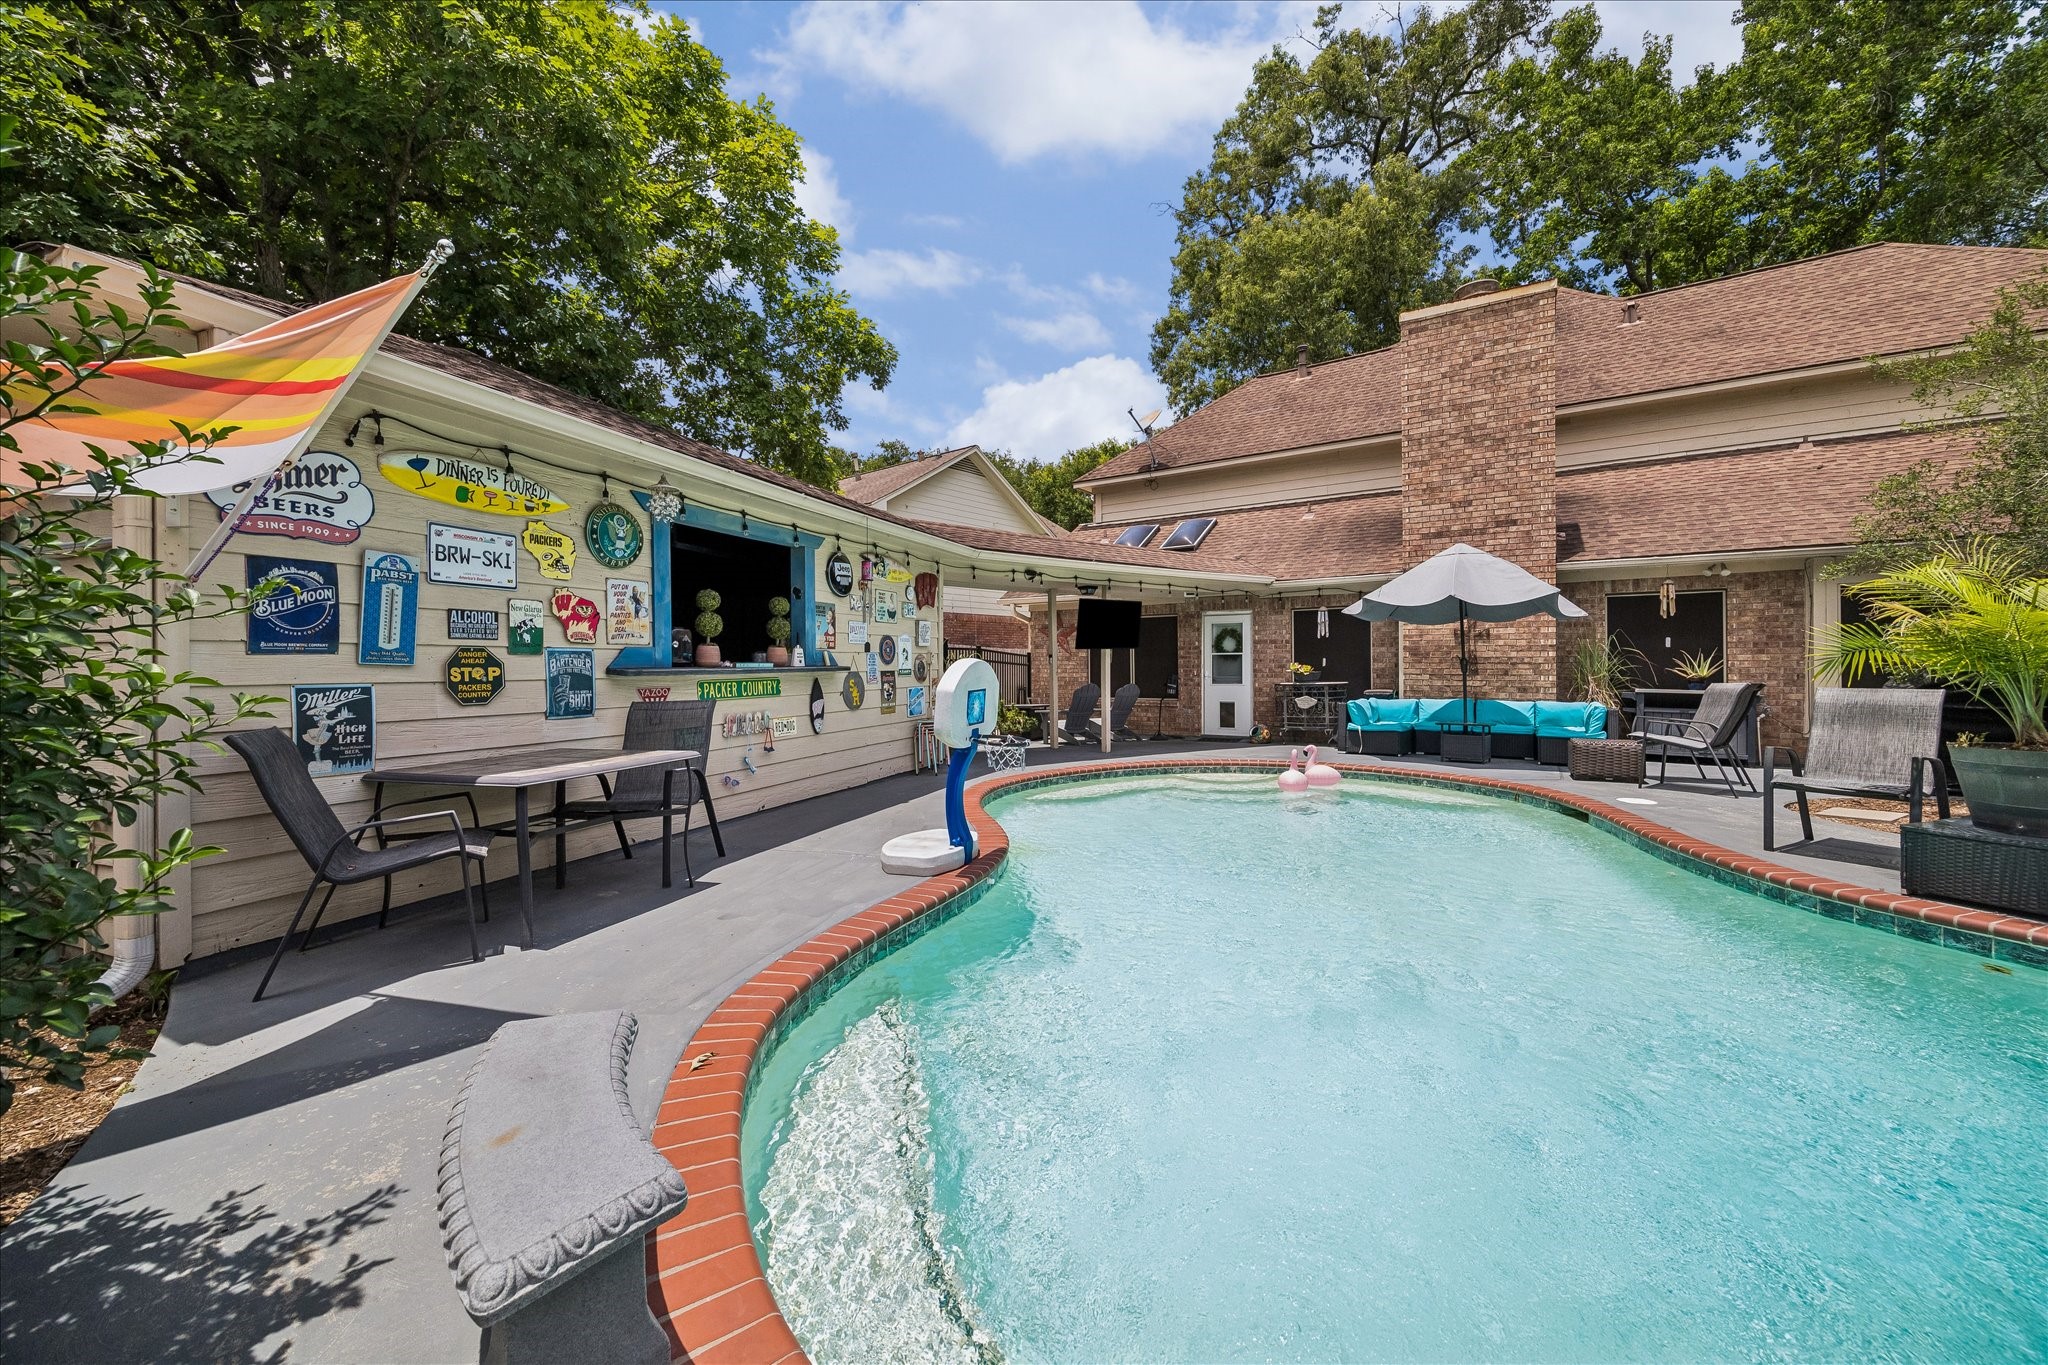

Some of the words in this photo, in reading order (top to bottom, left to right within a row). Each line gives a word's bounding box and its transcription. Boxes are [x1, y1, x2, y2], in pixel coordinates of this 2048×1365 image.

[436, 458, 487, 488] DINNER
[486, 467, 498, 483] IS
[254, 496, 335, 518] BEERS
[594, 505, 617, 522] UNITED
[257, 520, 295, 531] SINCE
[302, 525, 330, 537] 1909
[529, 533, 563, 548] PACKERS
[435, 543, 512, 570] BRW-SKI
[604, 557, 629, 566] ARMY
[370, 568, 415, 582] PABST
[837, 565, 851, 574] Jeep
[255, 597, 295, 617] BLUE
[297, 588, 333, 606] MOON
[511, 604, 523, 612] New
[523, 604, 542, 614] Glarus
[450, 610, 498, 624] ALCOHOL
[275, 627, 301, 635] DENVER
[304, 616, 331, 634] COLORADO
[549, 658, 592, 673] BARTENDER
[458, 683, 492, 691] PACKERS
[640, 688, 669, 696] YAZOO
[703, 681, 738, 698] PACKER
[742, 680, 778, 696] COUNTRY
[298, 688, 361, 711] Miller
[568, 694, 592, 709] SHOT
[334, 722, 367, 734] HIGH
[335, 732, 365, 744] LIFE
